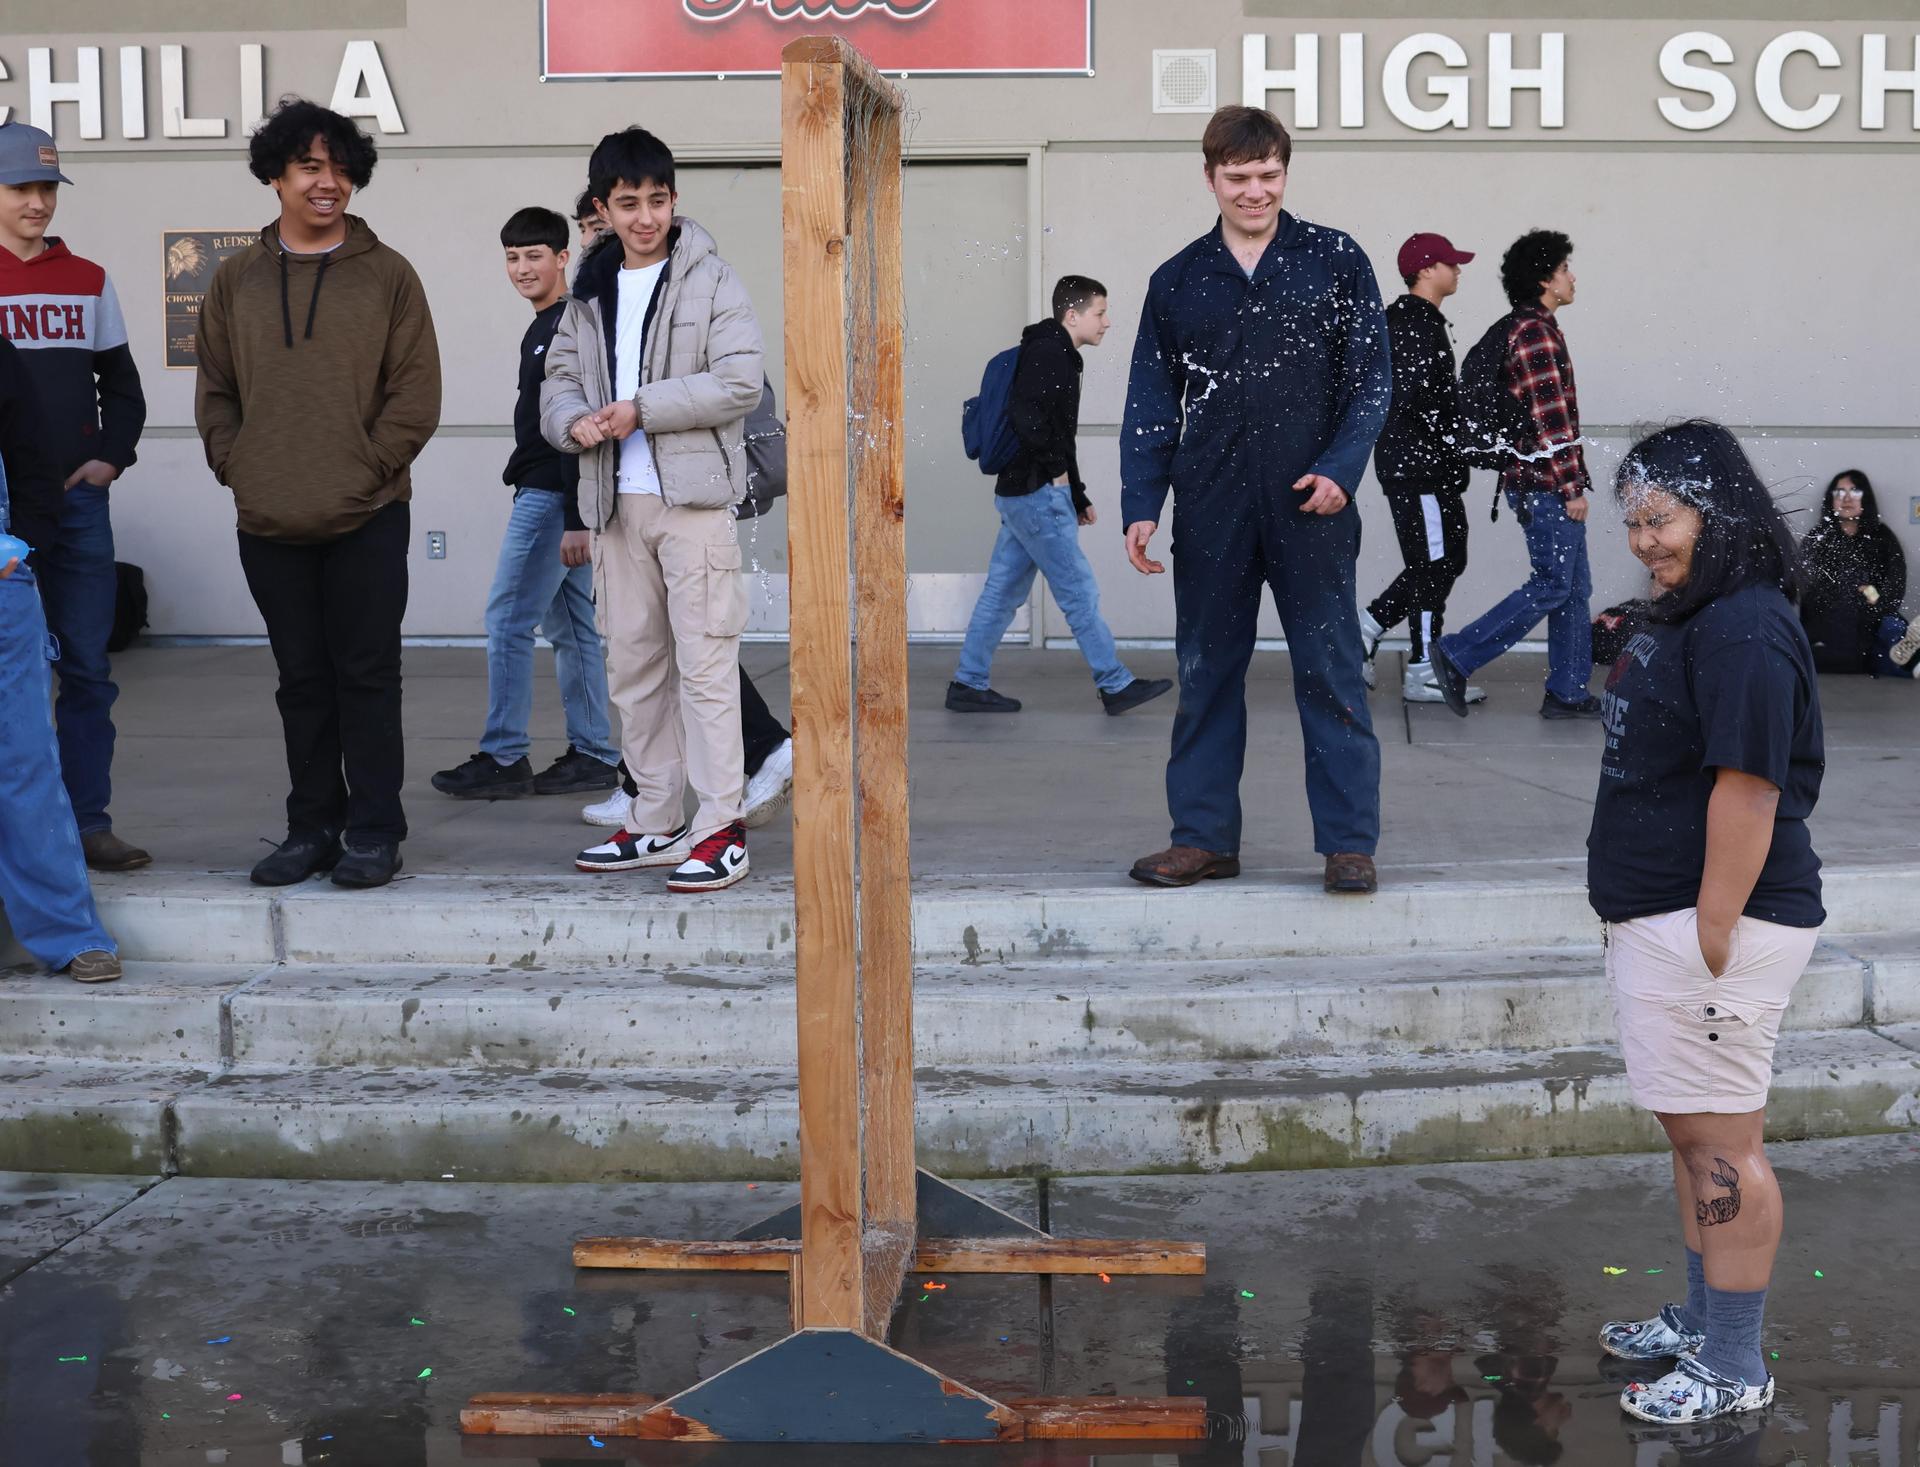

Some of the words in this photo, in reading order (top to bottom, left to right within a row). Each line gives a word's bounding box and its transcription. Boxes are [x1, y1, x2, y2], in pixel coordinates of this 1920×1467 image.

[1243, 32, 1564, 130] HIGH
[1656, 30, 1920, 130] SCH
[212, 235, 261, 249] REDSK
